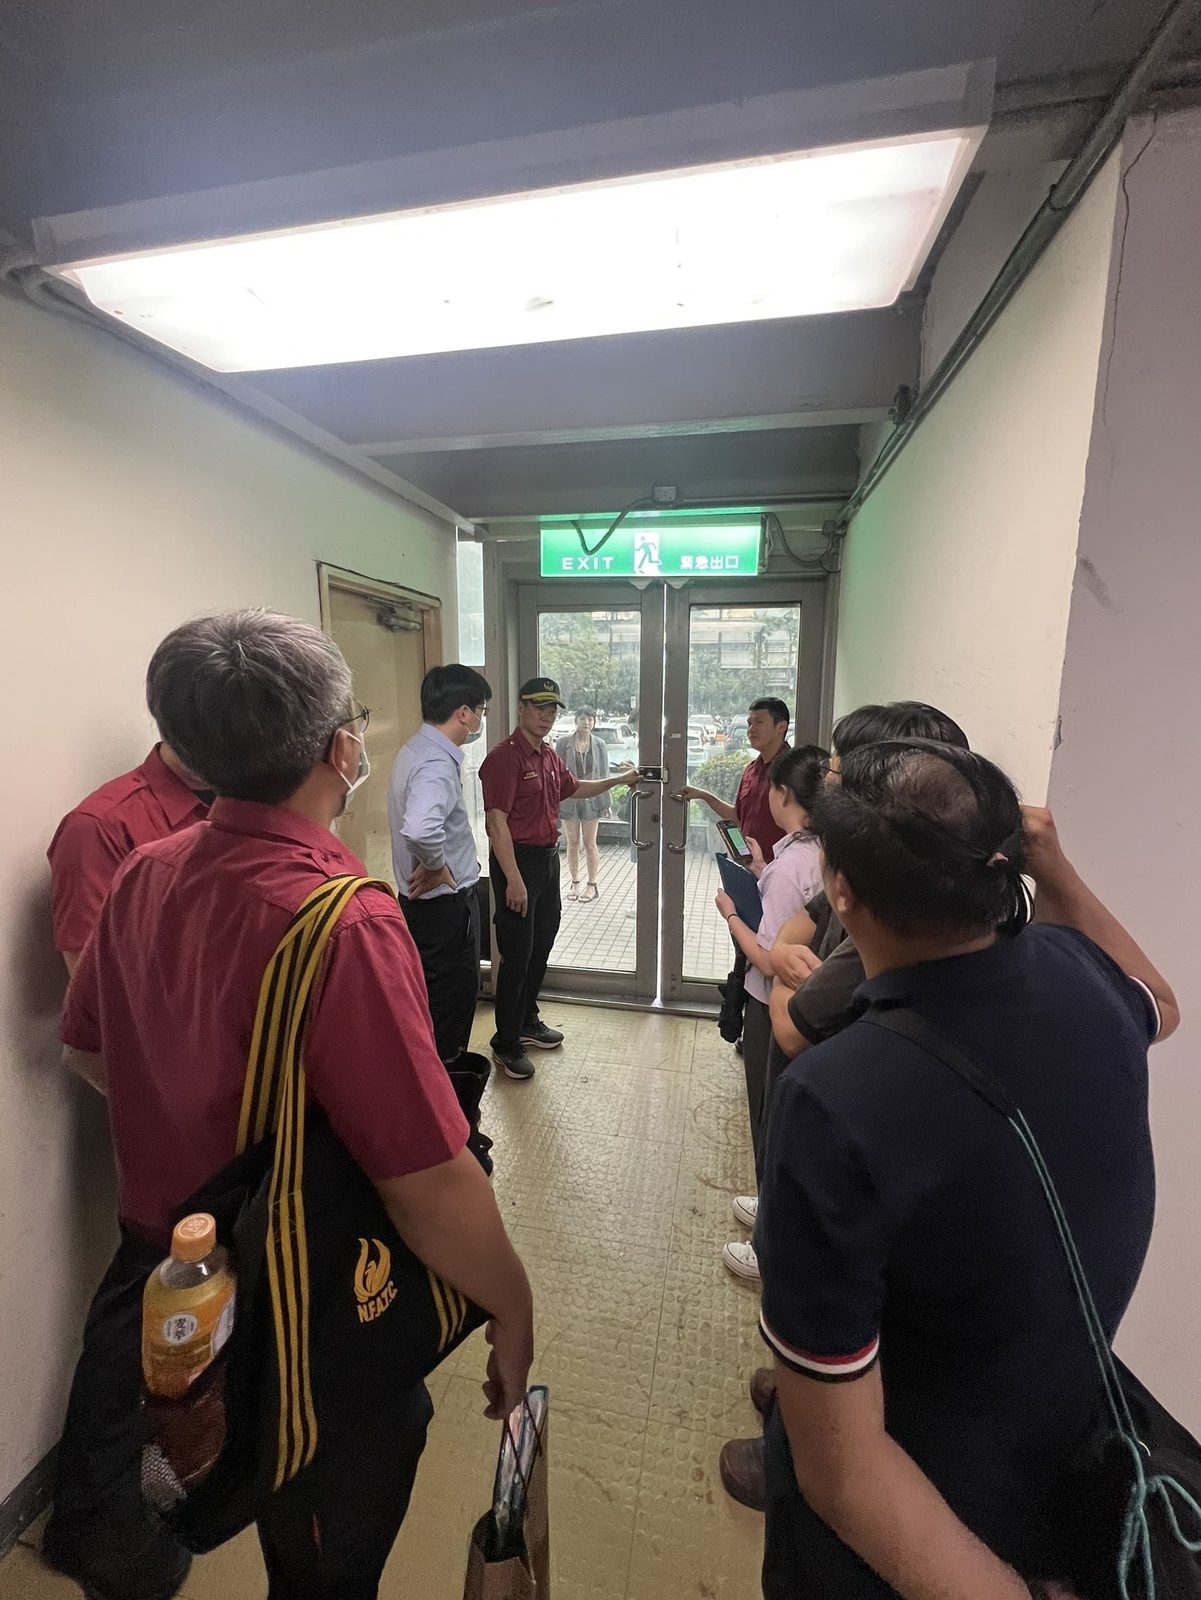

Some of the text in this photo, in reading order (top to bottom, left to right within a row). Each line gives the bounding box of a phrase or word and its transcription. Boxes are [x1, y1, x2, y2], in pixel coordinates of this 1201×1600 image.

[562, 557, 614, 570] EXIT
[680, 555, 739, 570] 緊急出口
